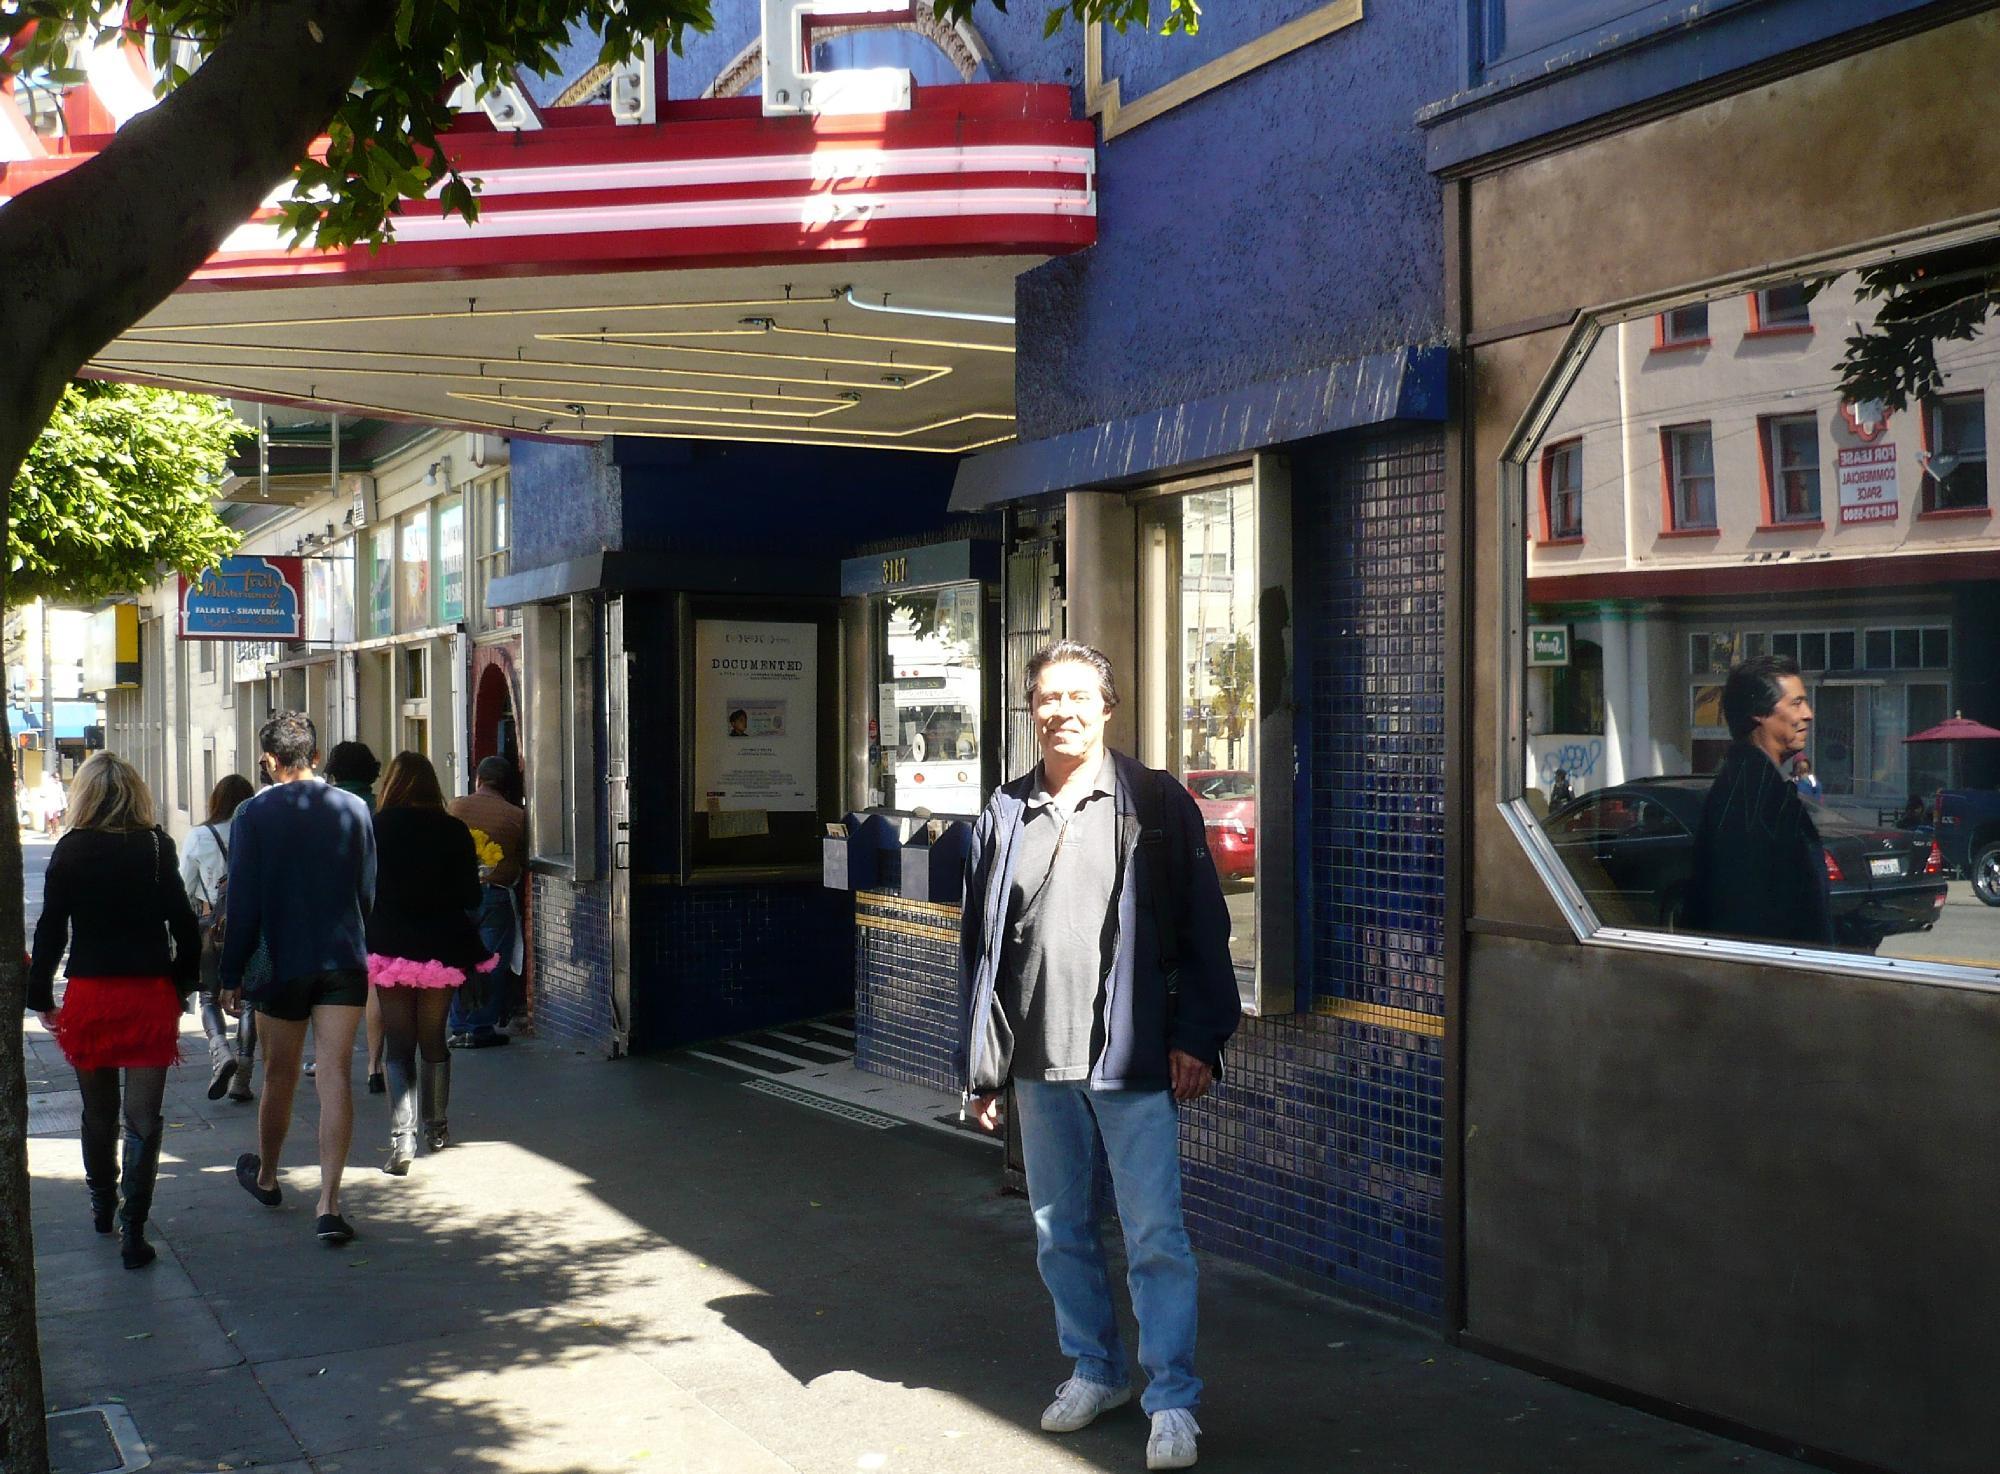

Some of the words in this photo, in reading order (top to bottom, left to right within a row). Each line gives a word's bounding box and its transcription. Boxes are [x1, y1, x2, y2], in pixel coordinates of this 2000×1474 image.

[195, 607, 230, 615] FALAFEL
[236, 608, 286, 616] SHAWERMA
[711, 658, 803, 671] DOCUMENTED
